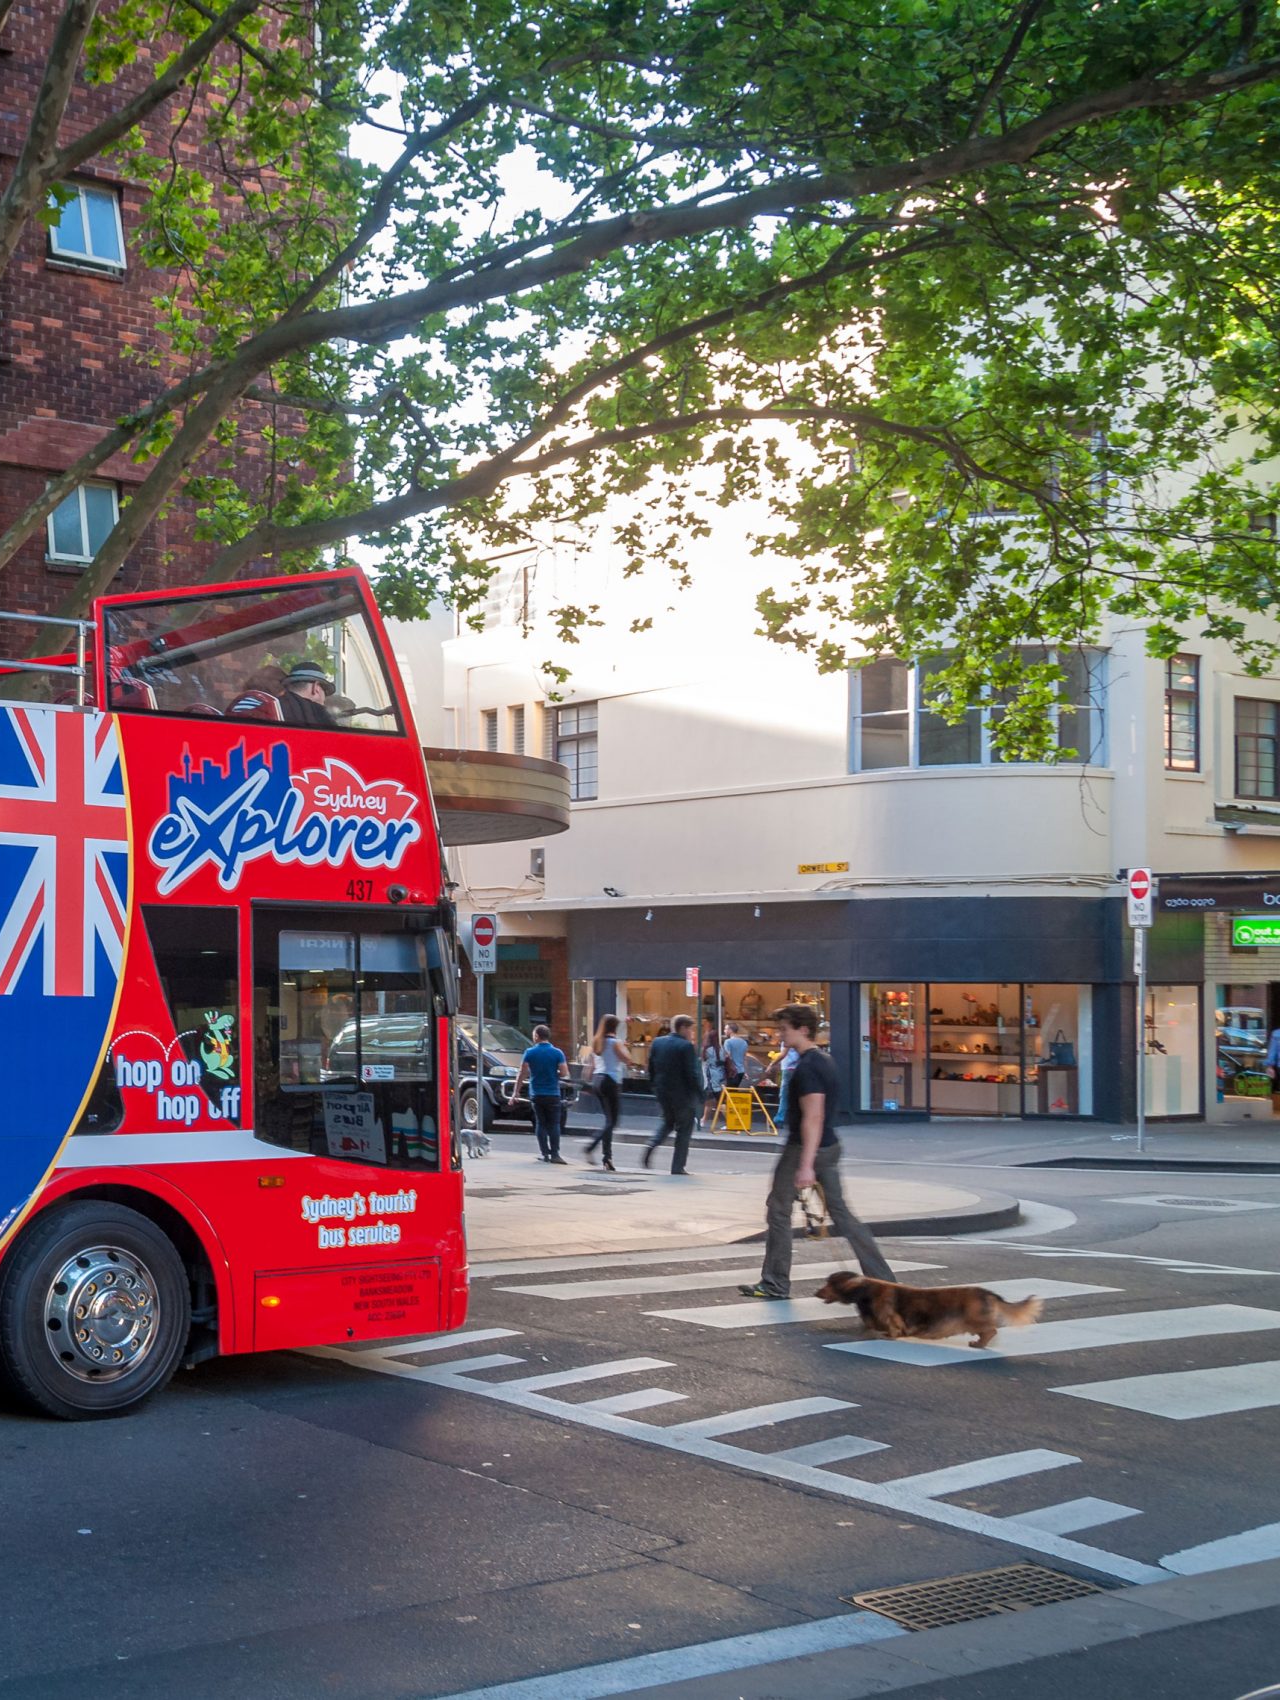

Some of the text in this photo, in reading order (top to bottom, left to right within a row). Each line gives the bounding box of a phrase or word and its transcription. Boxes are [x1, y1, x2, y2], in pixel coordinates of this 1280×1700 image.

[313, 785, 387, 813] Sydney
[346, 880, 374, 901] 437
[474, 960, 494, 969] ENTRY
[478, 949, 490, 959] NO
[116, 1055, 201, 1092] hop on
[157, 1090, 200, 1126] hop
[301, 1188, 418, 1223] Sydney's tourist
[318, 1220, 401, 1248] bus service
